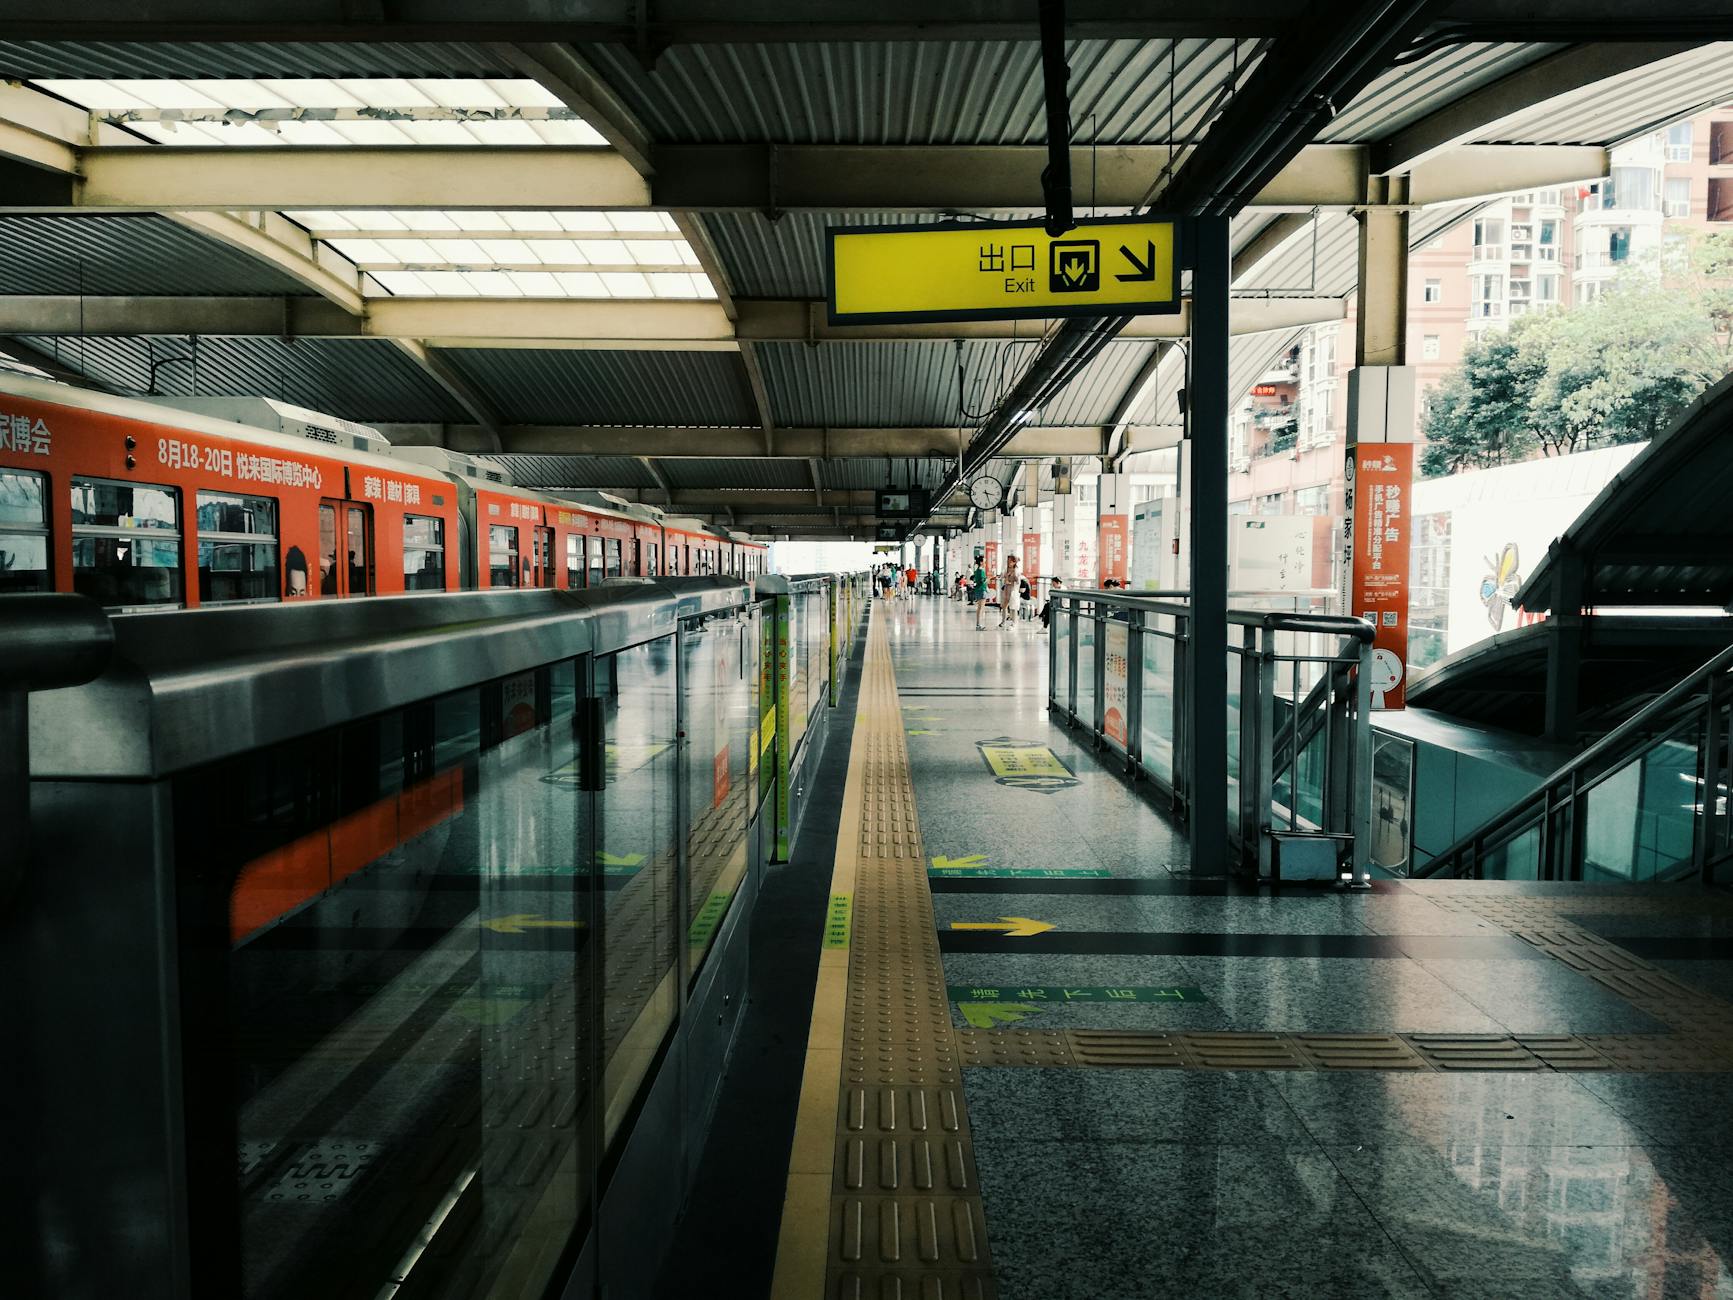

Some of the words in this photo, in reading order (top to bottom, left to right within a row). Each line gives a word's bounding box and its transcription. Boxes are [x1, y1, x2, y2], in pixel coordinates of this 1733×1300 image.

[980, 243, 1035, 273] 出口
[1005, 278, 1035, 293] Exit
[158, 438, 232, 478] 8月18-20日
[236, 452, 323, 490] 悦来国际博览中心
[1384, 485, 1401, 542] 秒赚广告
